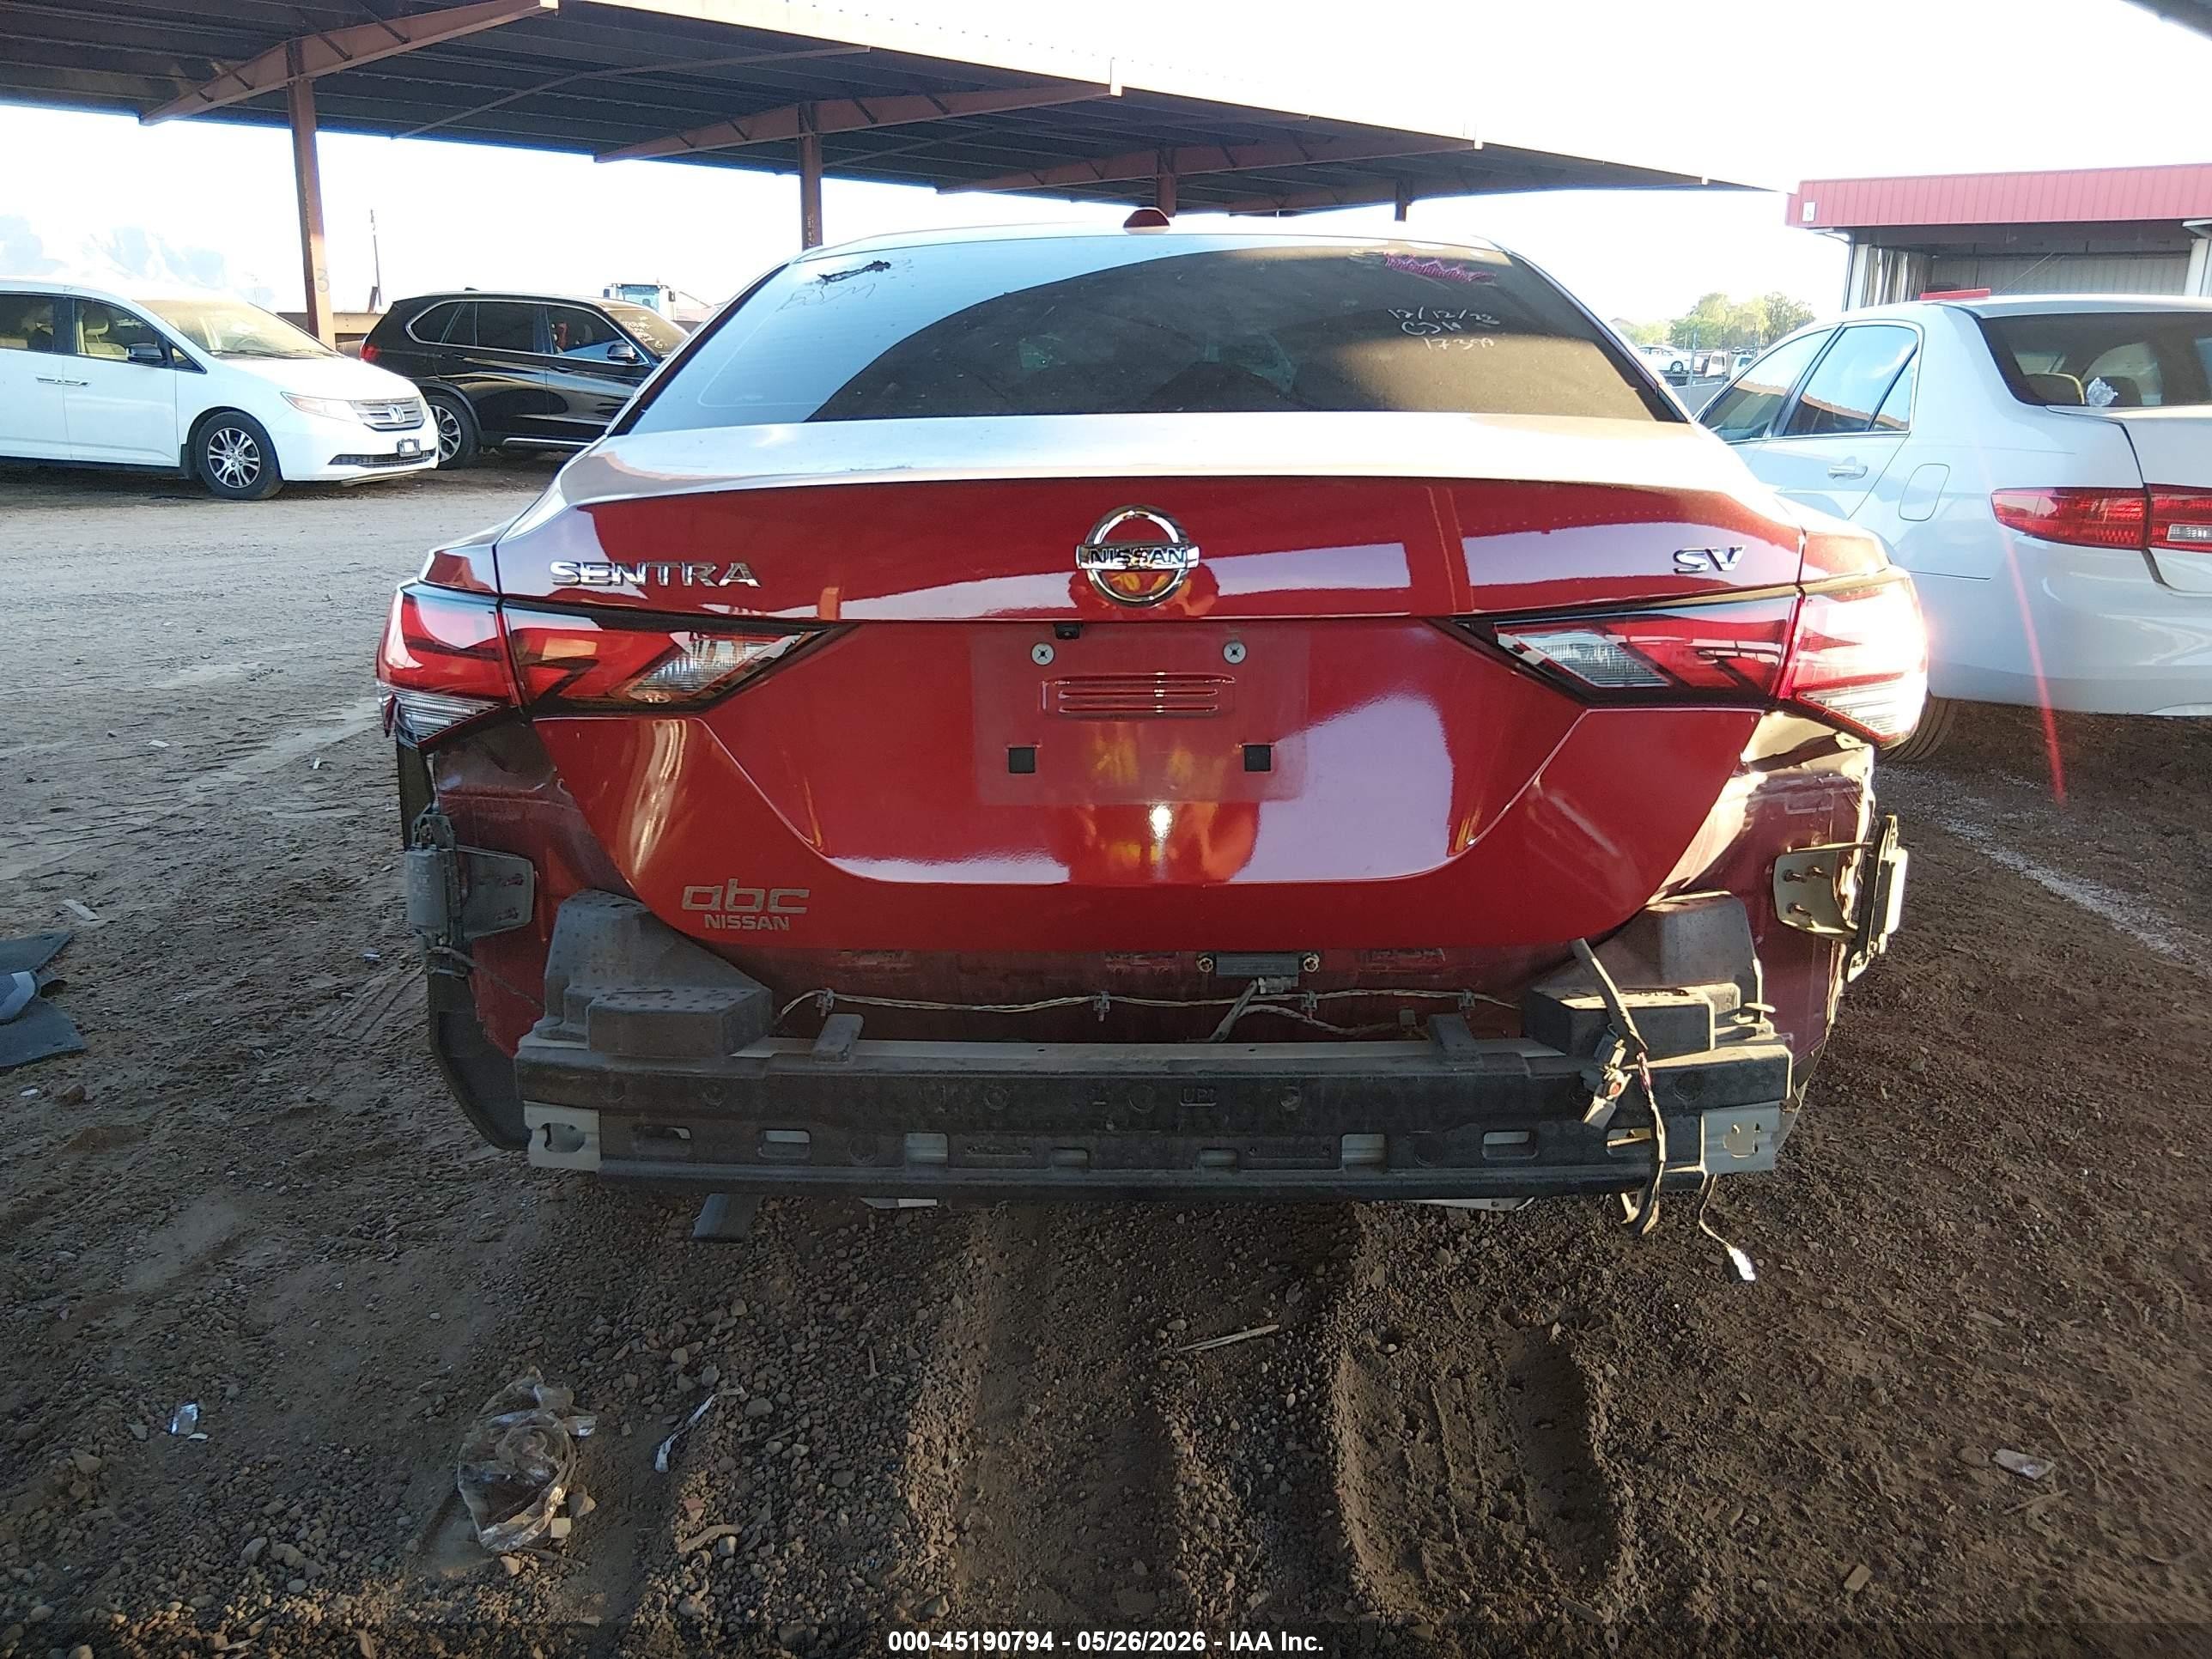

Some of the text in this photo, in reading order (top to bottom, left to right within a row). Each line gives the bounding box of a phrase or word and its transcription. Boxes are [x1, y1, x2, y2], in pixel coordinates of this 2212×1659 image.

[1090, 547, 1186, 567] NISSAN
[1672, 545, 1745, 574] SV
[550, 561, 762, 588] SENTRA
[681, 878, 811, 915] abc
[703, 914, 790, 931] NISSAN
